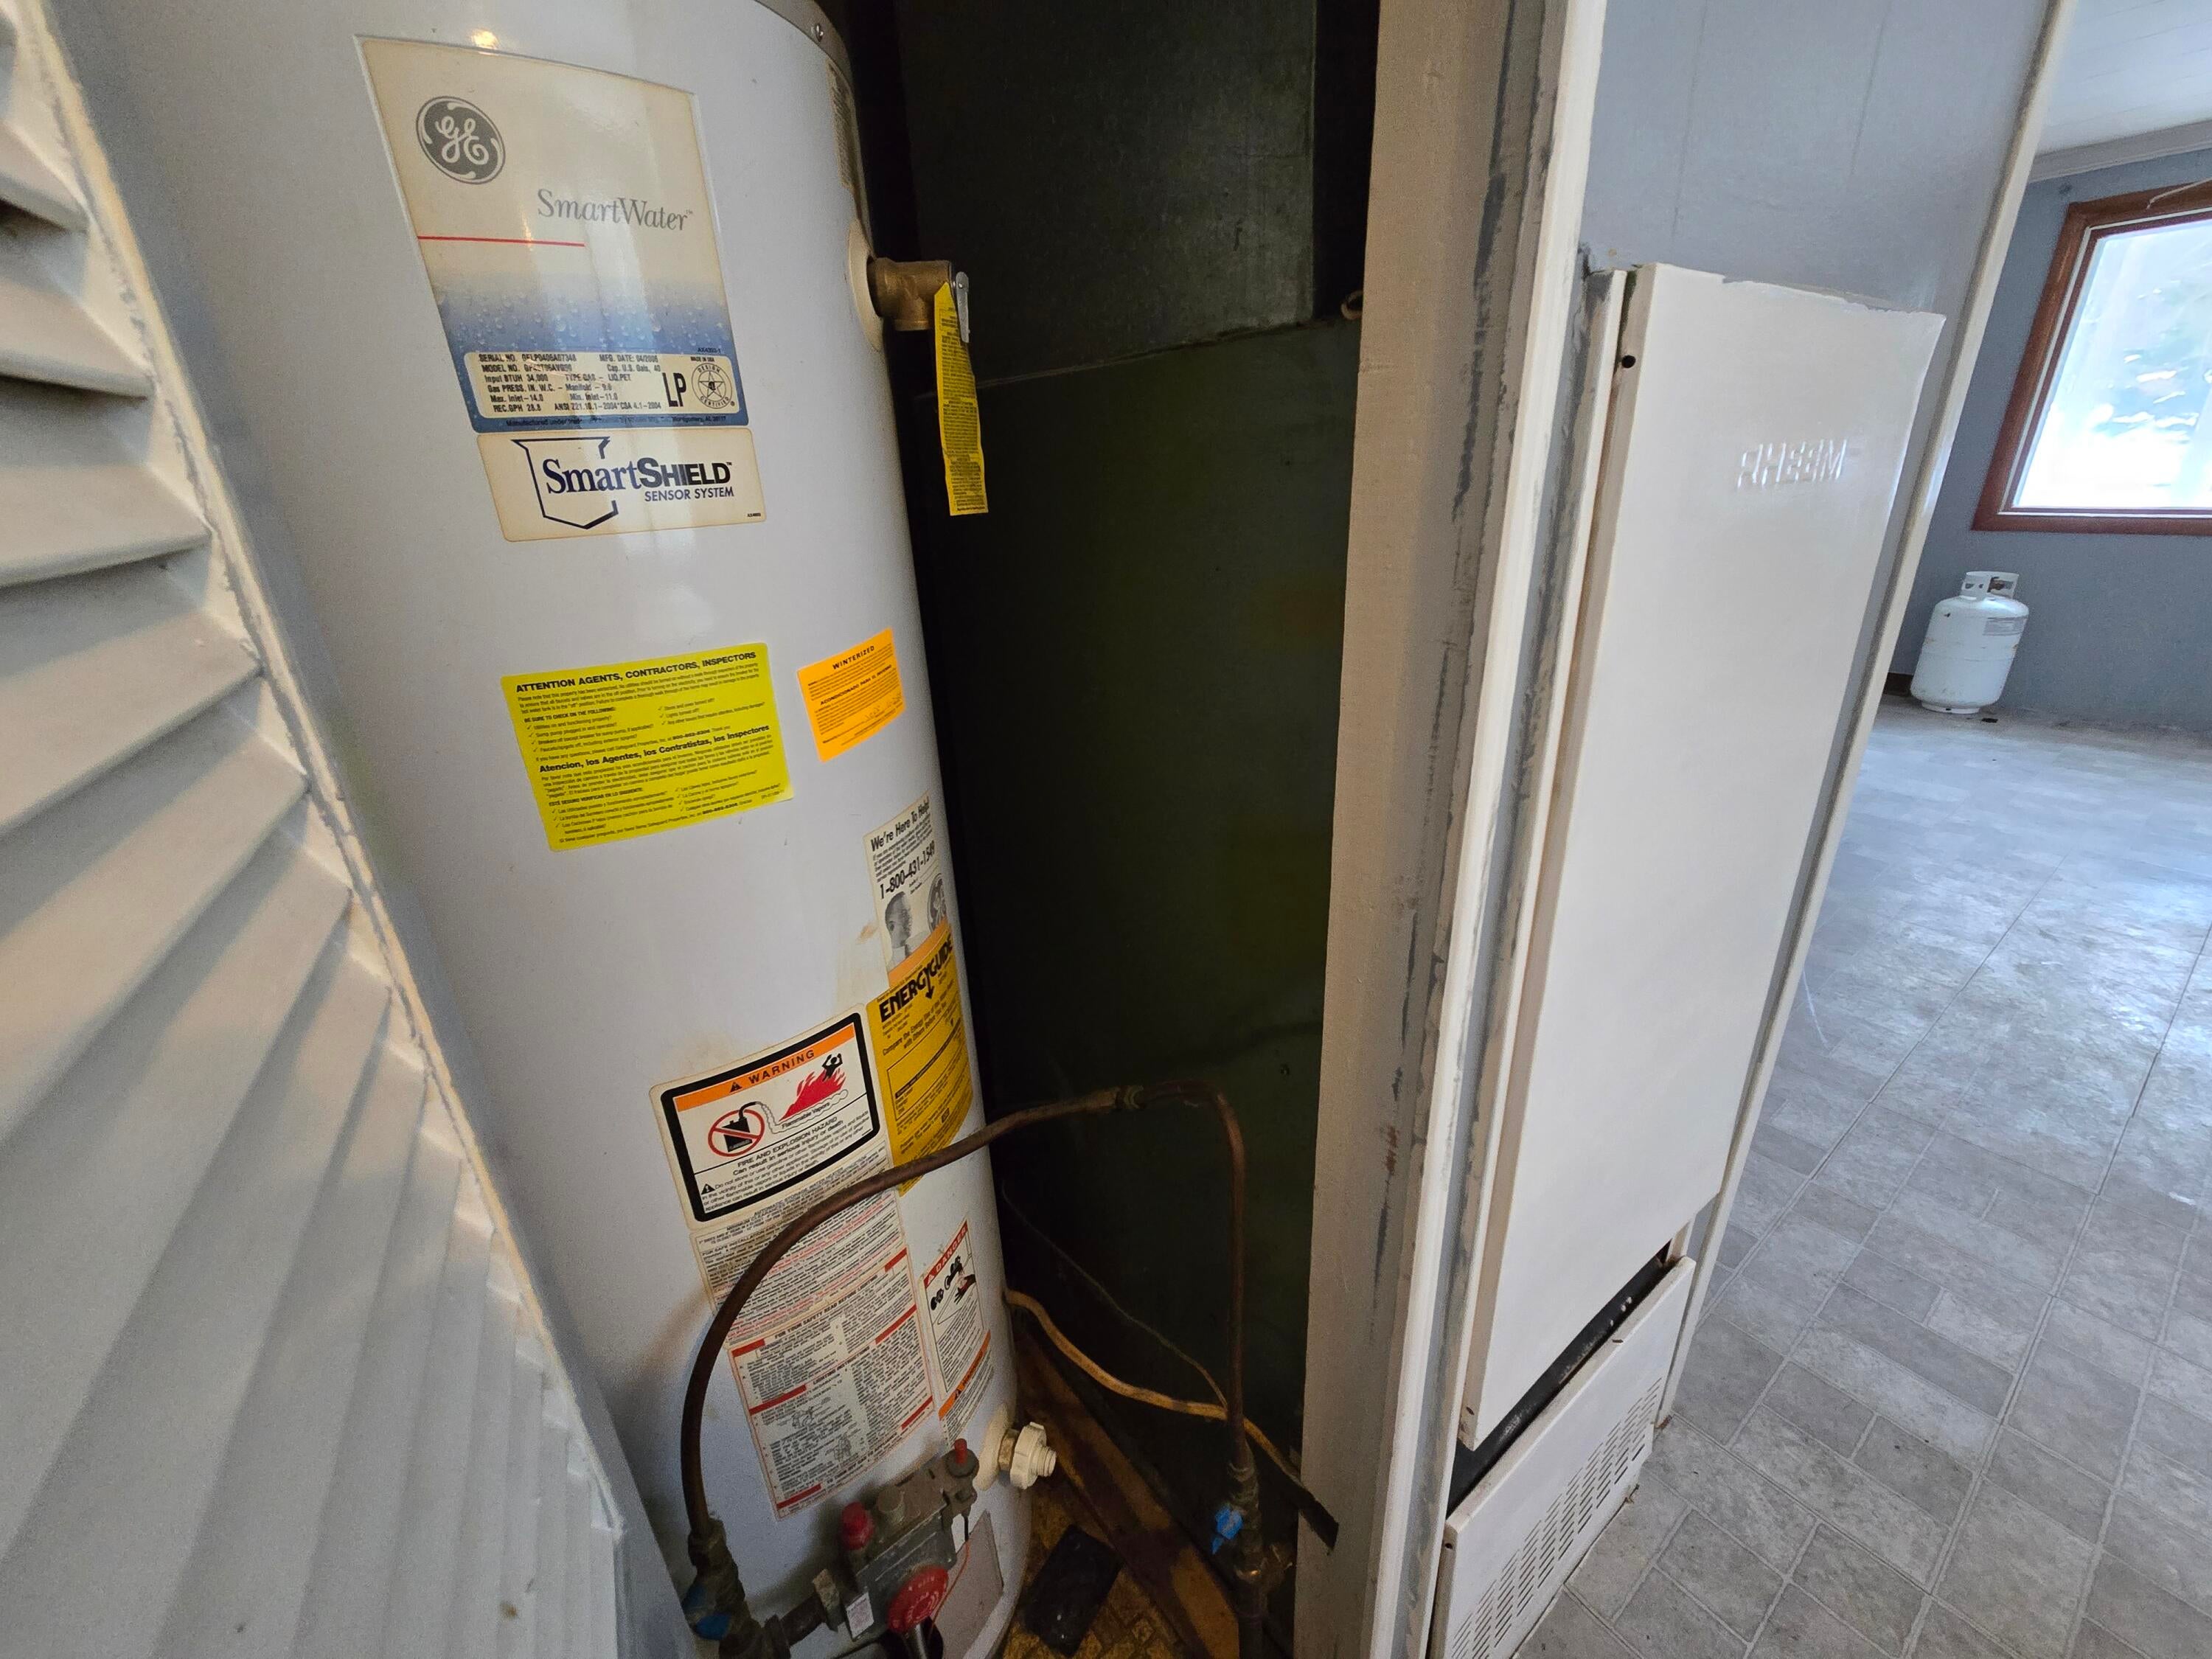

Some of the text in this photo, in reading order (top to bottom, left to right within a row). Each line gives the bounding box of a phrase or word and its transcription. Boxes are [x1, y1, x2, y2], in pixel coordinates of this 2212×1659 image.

[481, 364, 507, 372] MODEL
[504, 374, 523, 382] BTUH
[502, 384, 526, 392] PRESS.
[662, 372, 686, 407] LP
[644, 487, 734, 502] SENSOR SYSTEM
[832, 645, 875, 670] WINTERIZED
[516, 653, 755, 692] ATTENTION AGENTS, CONTRACTORS, INSPECTORS
[539, 760, 583, 773] Atencion,
[602, 751, 641, 763] Agentes,
[660, 738, 711, 753] Contratistas,
[728, 725, 769, 738] Inspectores
[895, 819, 911, 837] Here
[911, 811, 918, 824] To
[748, 1049, 815, 1085] WARNING
[781, 1101, 830, 1129] Flammable Vapors
[733, 1167, 746, 1175] Can
[748, 1159, 767, 1169] result
[777, 1145, 800, 1156] serious
[801, 1135, 819, 1144] injury
[828, 1121, 843, 1130] death
[737, 1118, 837, 1166] FIRE AND EXPLOSION HAZARD
[804, 1311, 822, 1324] SAFETY
